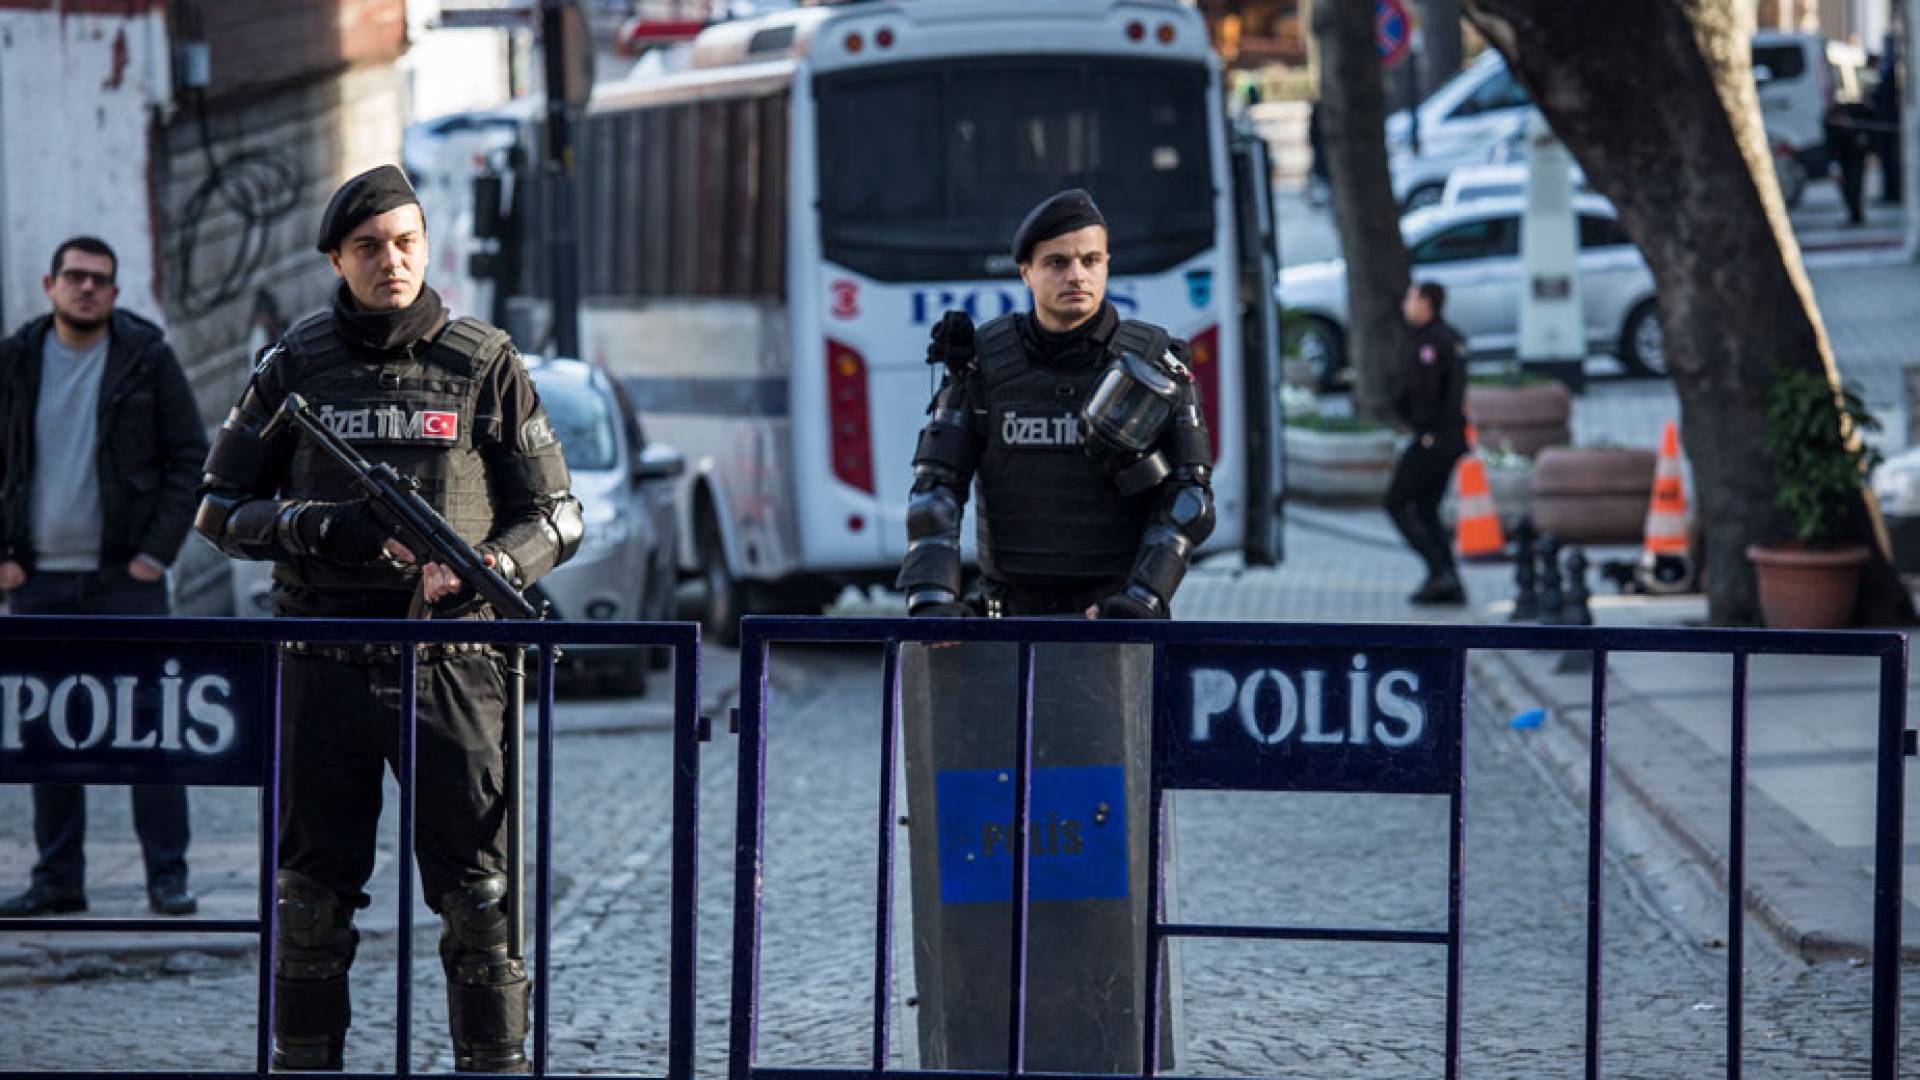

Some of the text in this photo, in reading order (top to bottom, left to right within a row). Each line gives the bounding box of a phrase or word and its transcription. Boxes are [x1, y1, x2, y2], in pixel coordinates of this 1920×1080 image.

[911, 285, 1139, 325] POS
[0, 658, 236, 754] POLİS
[1190, 653, 1425, 746] POLİS
